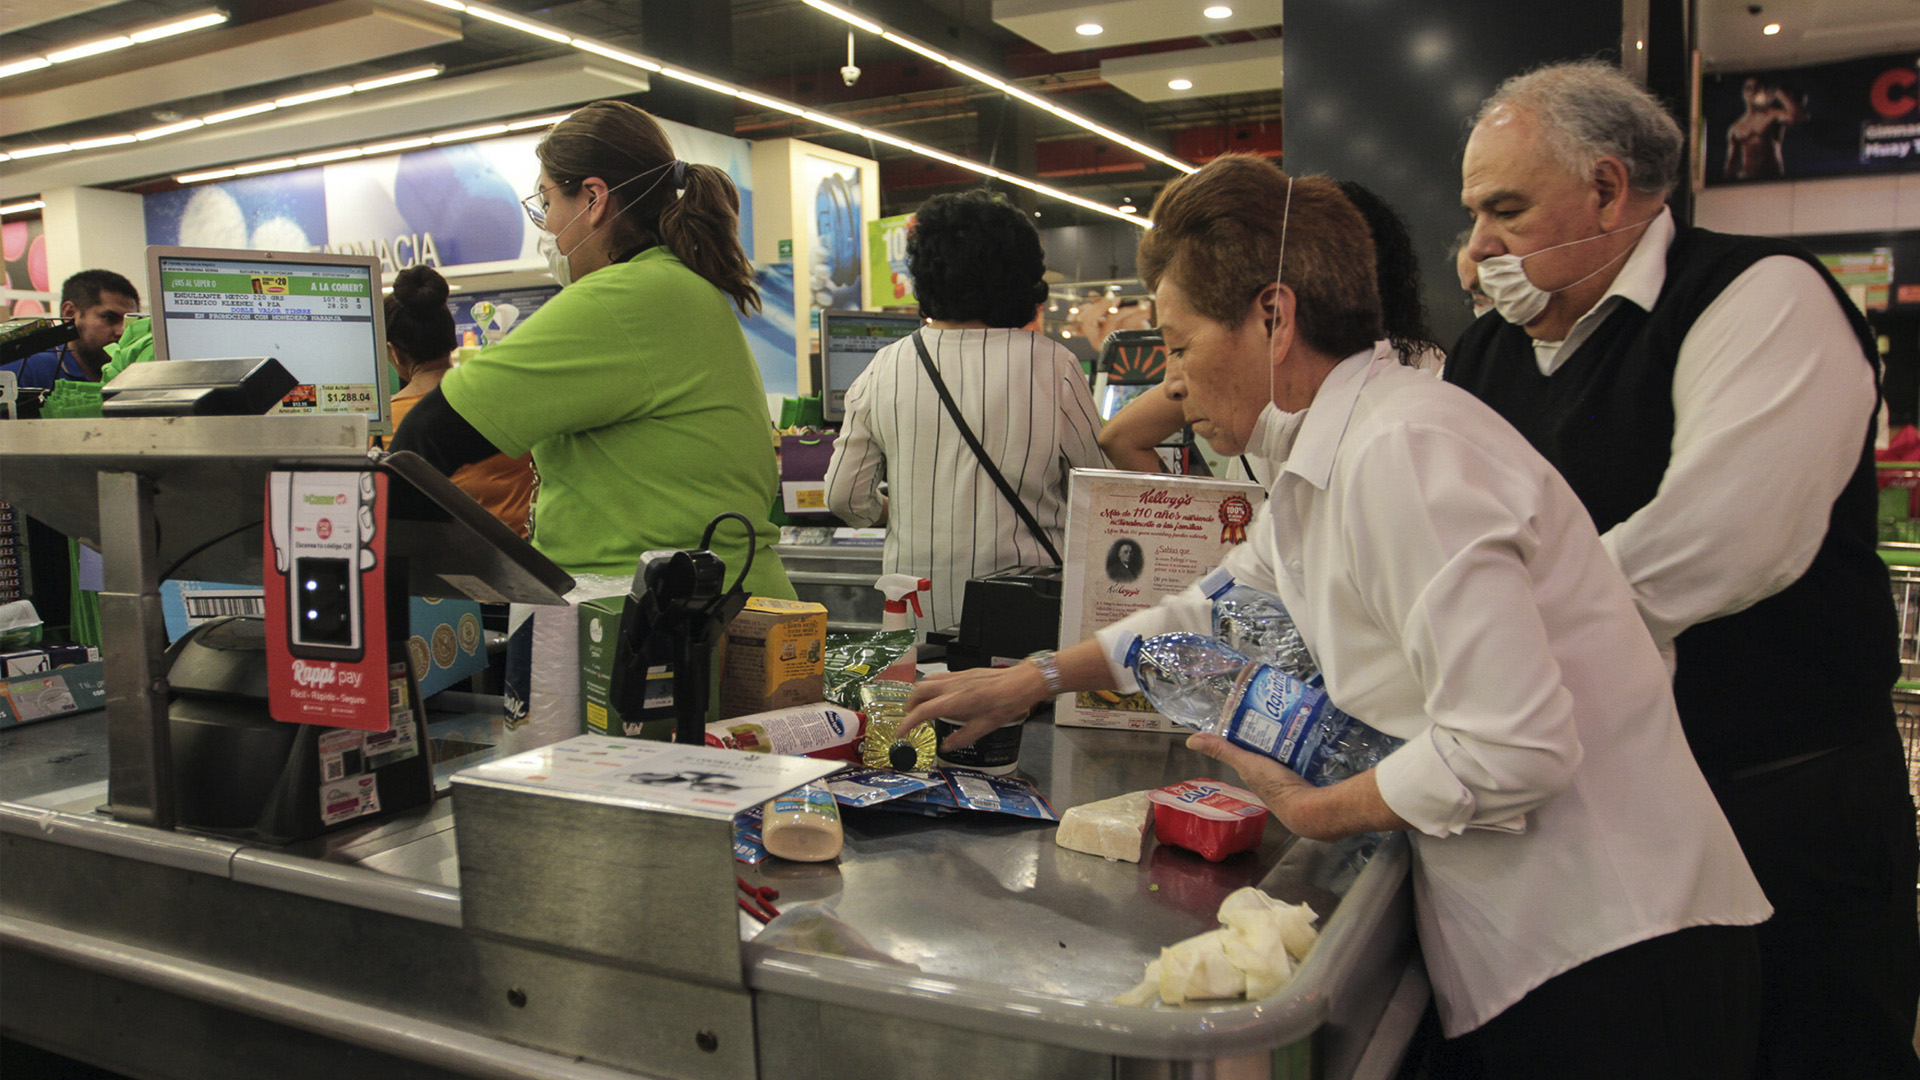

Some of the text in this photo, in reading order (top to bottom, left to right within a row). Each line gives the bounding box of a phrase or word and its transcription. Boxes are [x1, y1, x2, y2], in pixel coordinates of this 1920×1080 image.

[185, 279, 192, 288] AL
[311, 282, 364, 293] A LA COMER?
[327, 393, 371, 403] $1,288.04
[1138, 488, 1193, 509] Kellogg's
[1121, 509, 1131, 517] de
[1133, 507, 1152, 518] 110
[1154, 509, 1182, 521] años
[1182, 514, 1215, 523] nutriendo
[1226, 506, 1245, 515] 100%
[1109, 519, 1155, 528] naturalmente
[1163, 521, 1174, 529] las
[1174, 521, 1203, 534] familias
[292, 660, 363, 689] Rappi pay
[340, 694, 367, 705] Seguro
